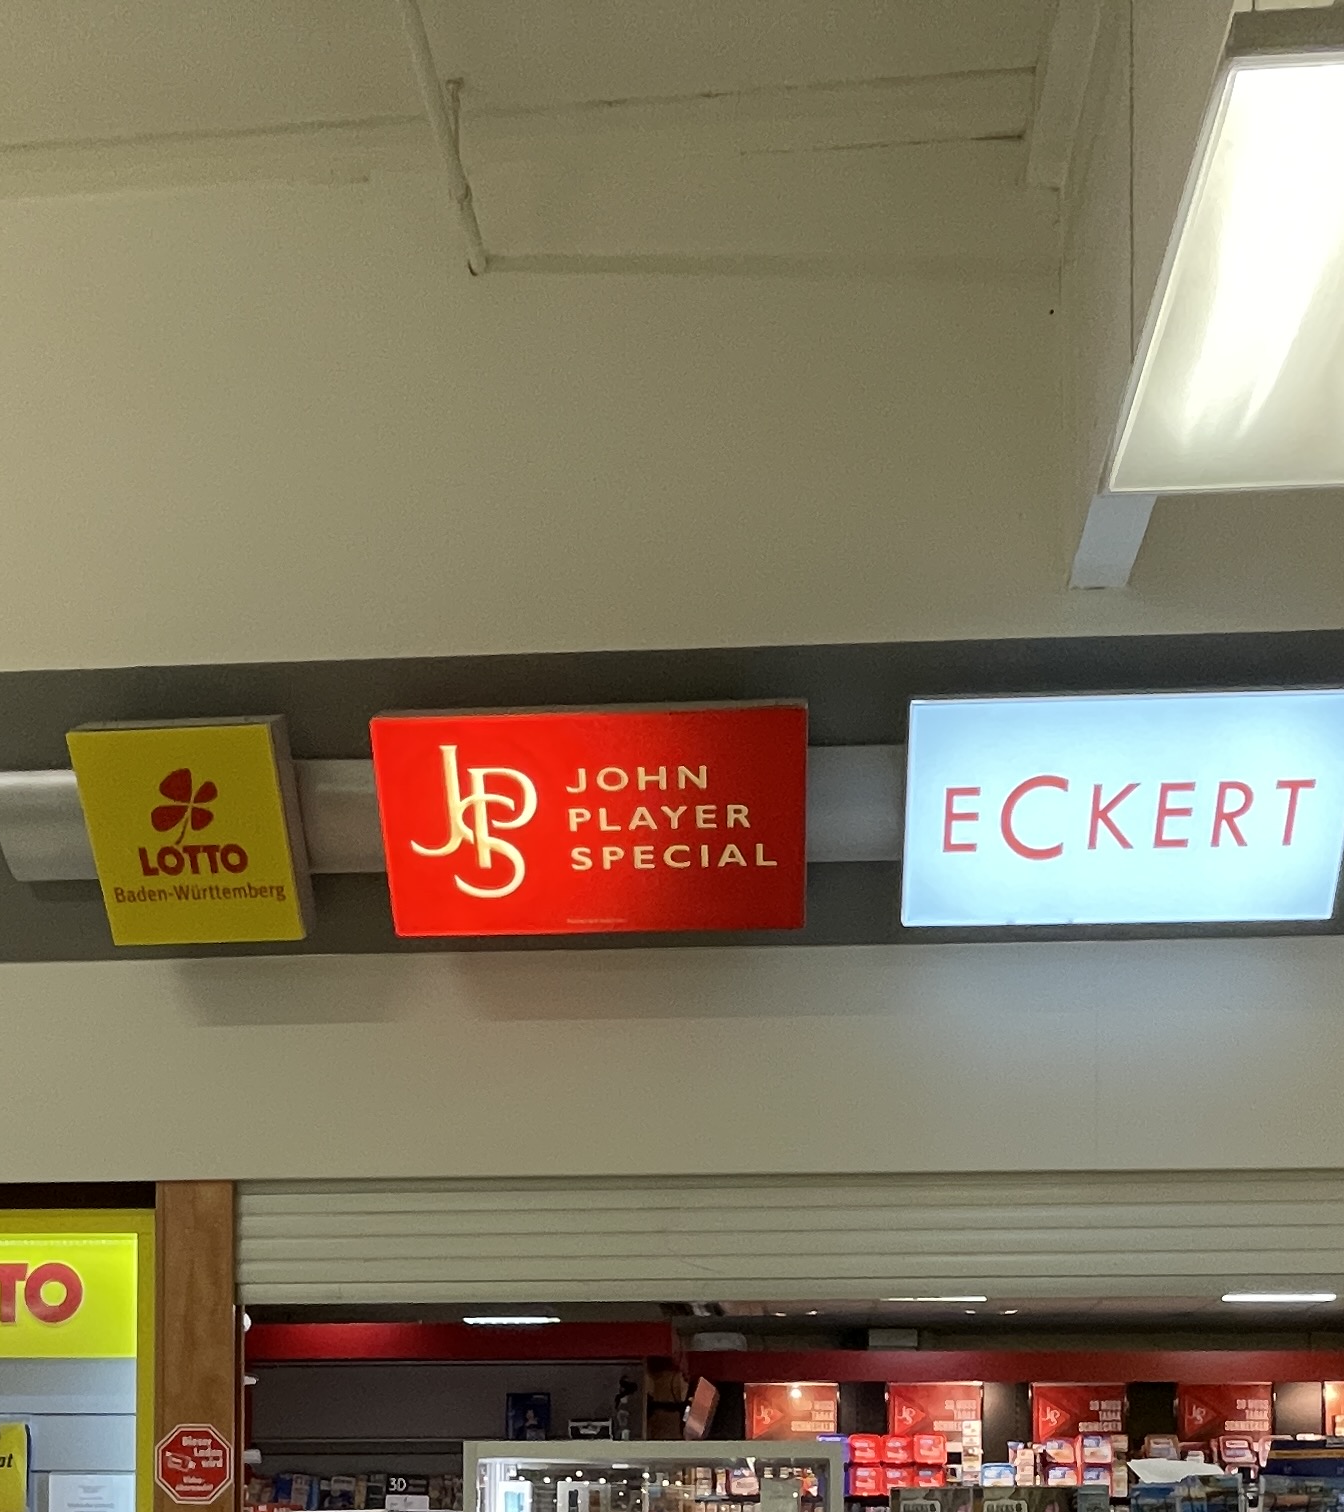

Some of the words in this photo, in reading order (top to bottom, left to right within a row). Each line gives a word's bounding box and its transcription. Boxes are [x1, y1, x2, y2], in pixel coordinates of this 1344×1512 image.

[565, 764, 709, 793] JOHN
[567, 804, 752, 832] PLAYER
[943, 774, 1317, 861] ECKERT
[138, 843, 248, 876] LOTTO
[570, 843, 778, 871] SPECIAL
[114, 882, 287, 903] Baden-Württemberg
[388, 1478, 406, 1491] 3D
